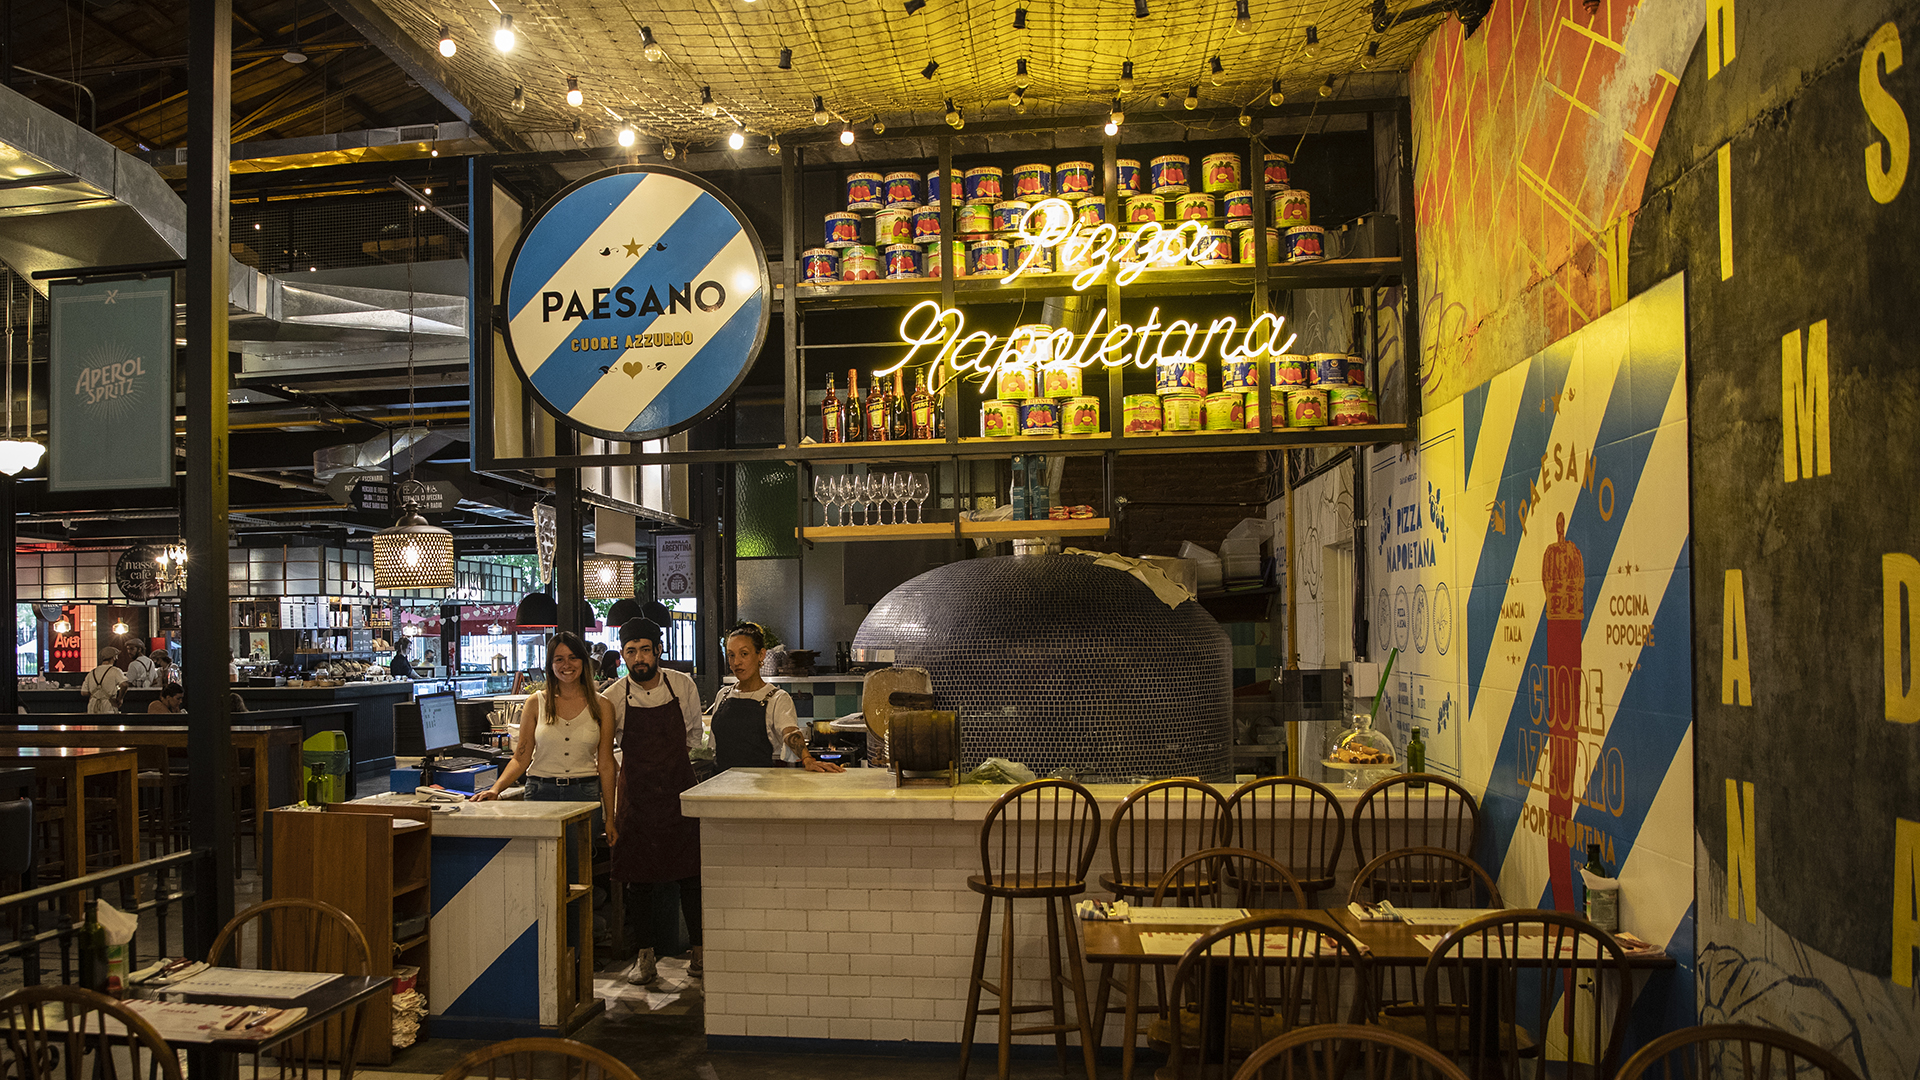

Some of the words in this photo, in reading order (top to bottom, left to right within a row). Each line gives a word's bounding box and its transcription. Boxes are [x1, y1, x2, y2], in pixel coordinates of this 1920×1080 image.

[1000, 197, 1221, 292] Pizza
[541, 280, 727, 323] PAESANO
[570, 335, 619, 352] CUORE
[625, 330, 694, 350] AZZURRO
[75, 356, 146, 395] APEROL
[873, 300, 1298, 394] Napoletana
[1781, 319, 1832, 483] M
[1396, 501, 1423, 536] PIZZA
[1518, 441, 1615, 537] PAESANO
[1500, 601, 1526, 619] MANGIA
[1609, 593, 1650, 618] COCINA
[1721, 568, 1753, 707] A
[1527, 663, 1605, 736] CUORE
[1517, 727, 1626, 818] AZZURRO
[1725, 777, 1757, 924] N
